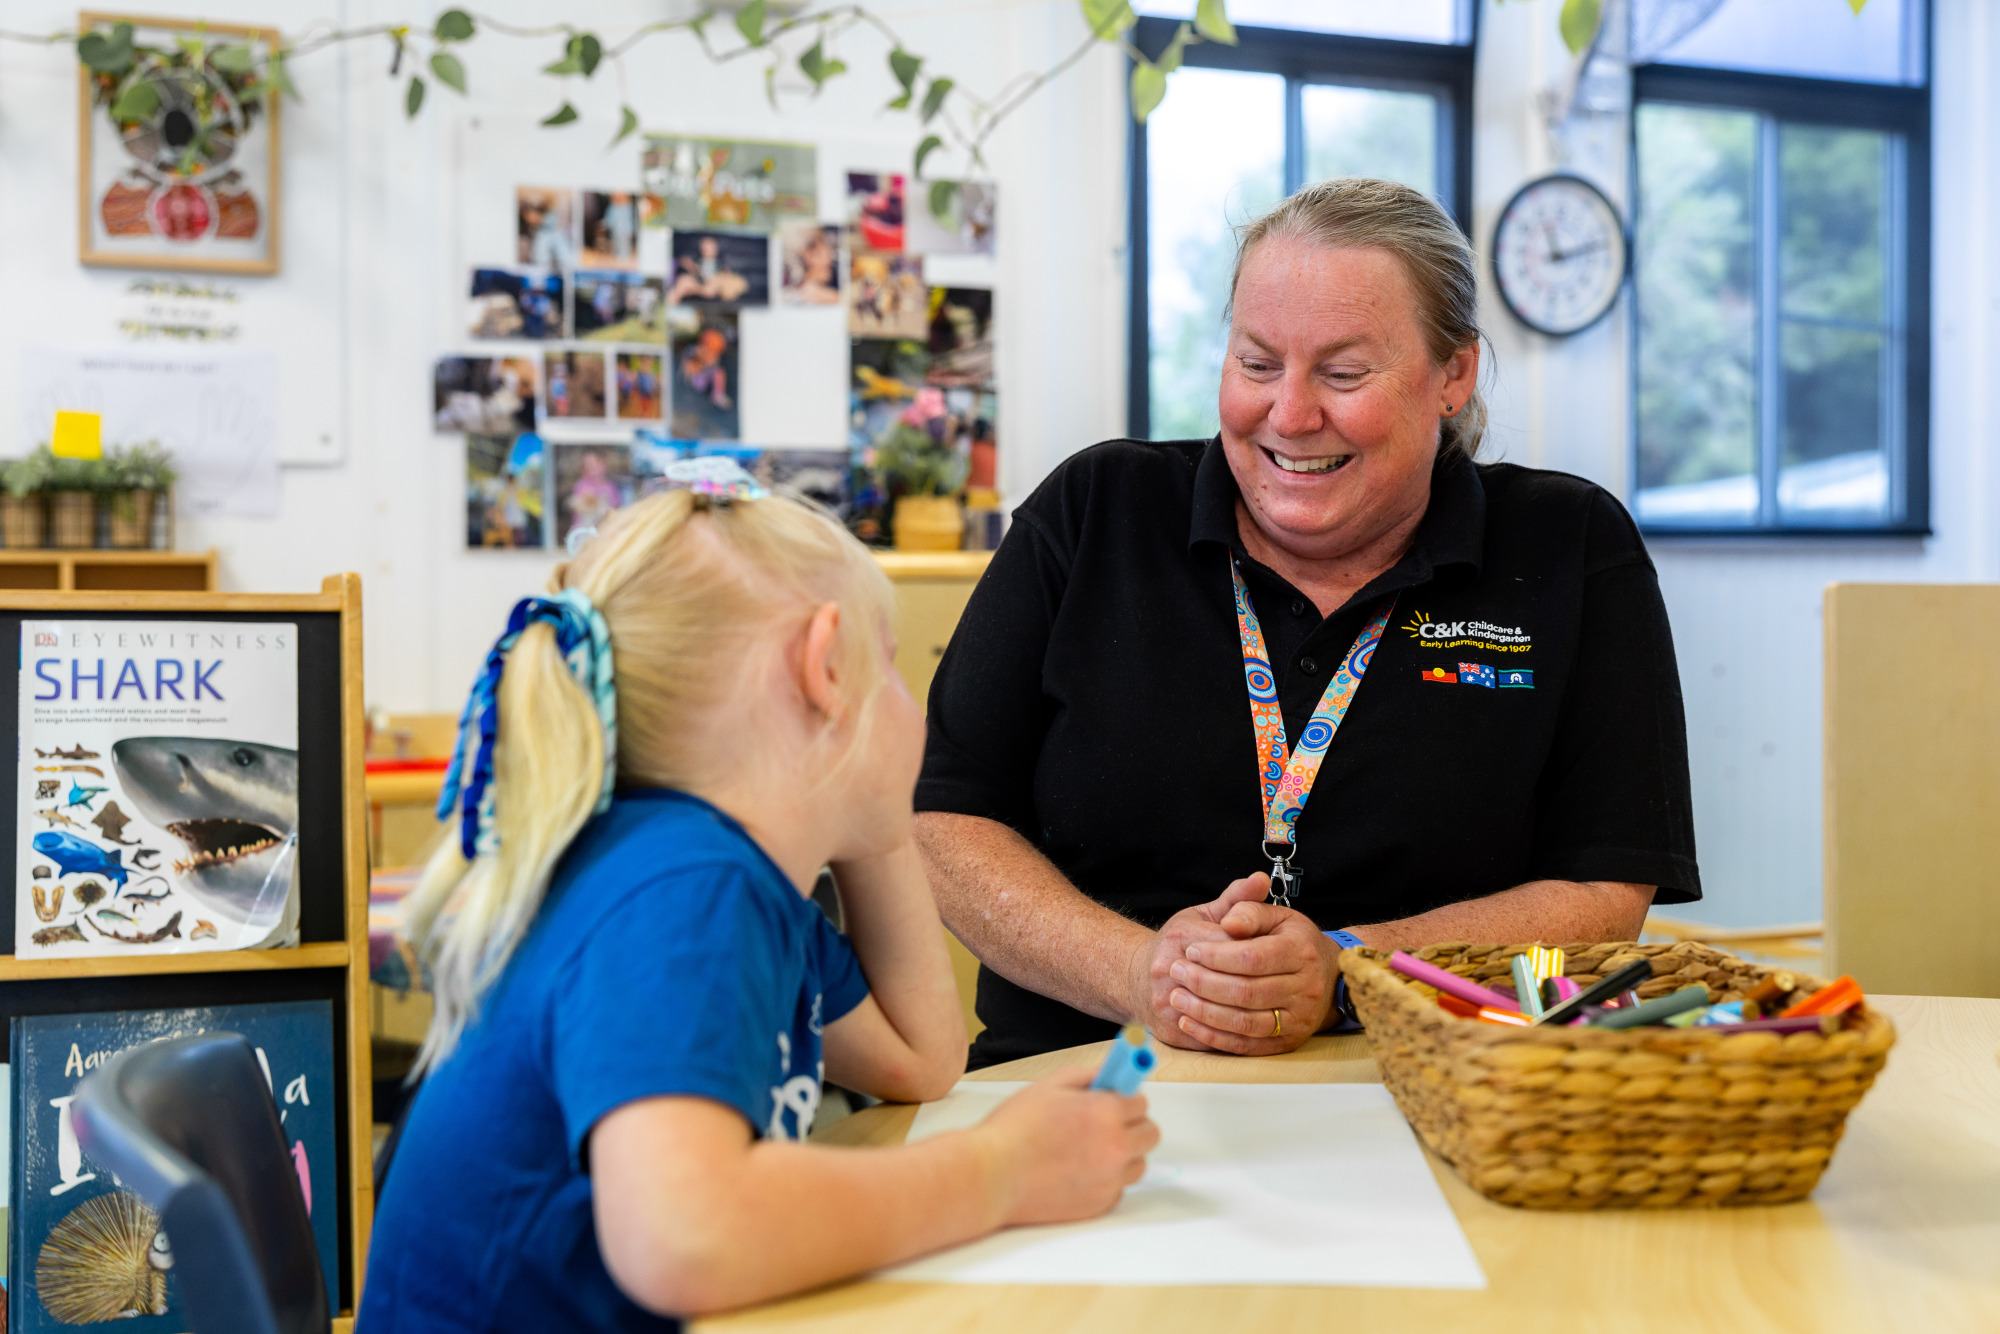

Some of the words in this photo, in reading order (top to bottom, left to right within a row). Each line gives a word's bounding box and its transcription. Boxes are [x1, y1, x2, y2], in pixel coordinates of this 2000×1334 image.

[1420, 621, 1467, 638] C&K
[1467, 621, 1514, 635] Childcare
[1514, 627, 1522, 635] &
[35, 632, 58, 647] DK
[72, 633, 286, 649] EYEWITNESS
[1467, 629, 1531, 643] Kindergarten
[1420, 640, 1443, 649] Early
[1444, 638, 1485, 649] Learning
[1486, 641, 1508, 652] since
[1508, 644, 1532, 652] 1907
[34, 658, 226, 701] SHARK
[155, 706, 168, 715] and
[189, 706, 201, 715] the
